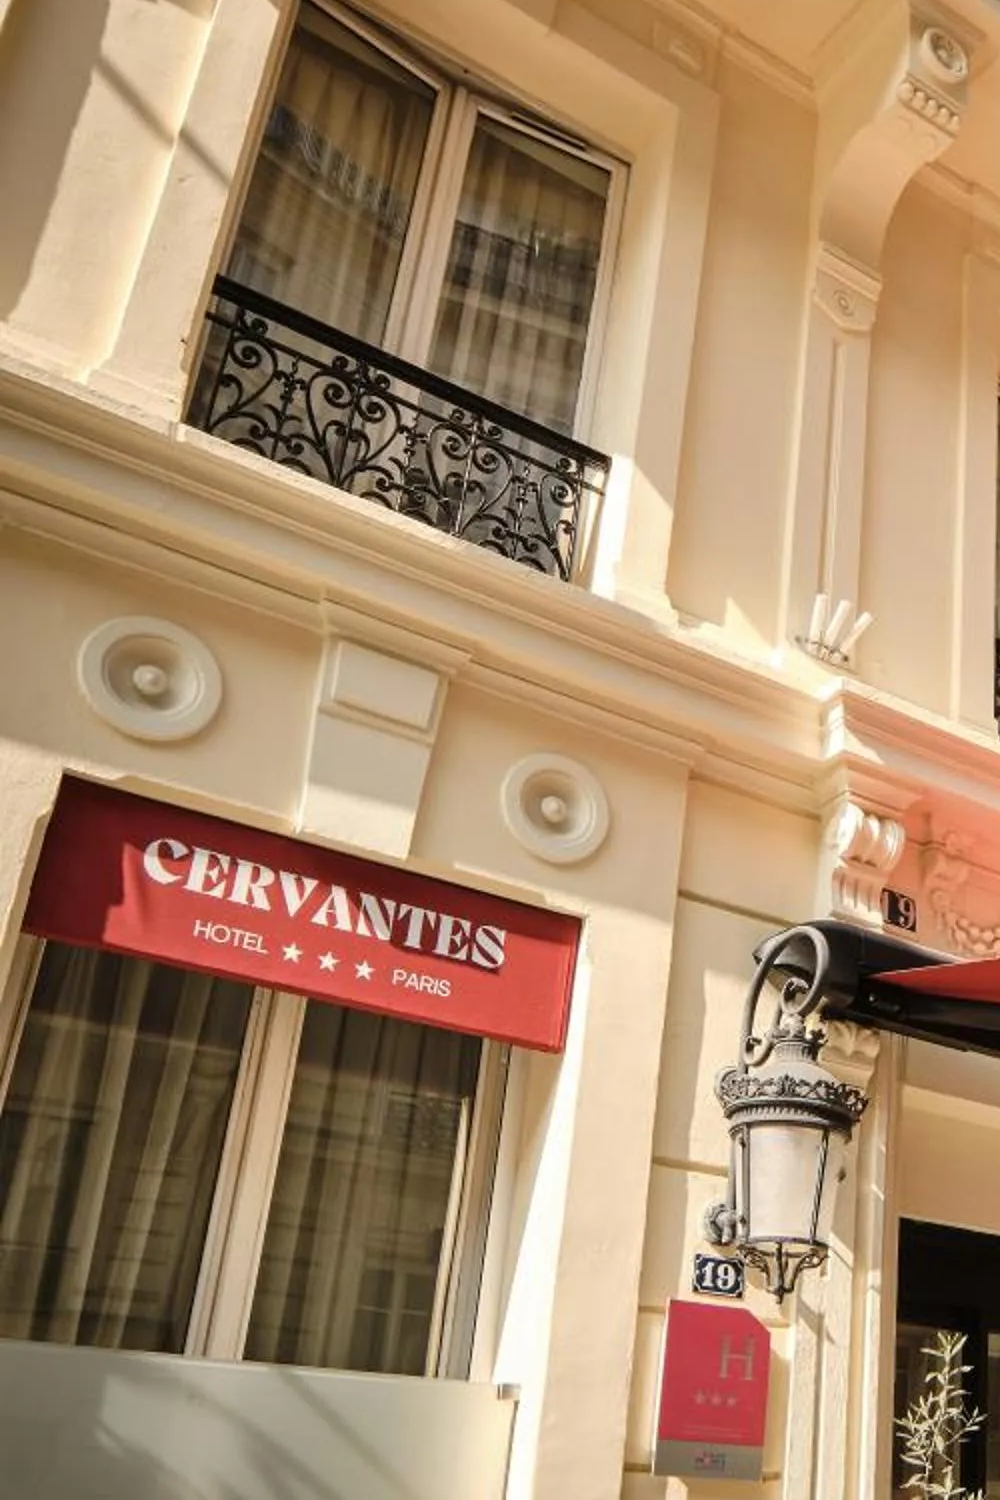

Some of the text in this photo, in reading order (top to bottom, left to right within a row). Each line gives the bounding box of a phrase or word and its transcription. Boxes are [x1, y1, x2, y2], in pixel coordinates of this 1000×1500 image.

[143, 837, 507, 970] CERVANTES
[883, 891, 916, 929] 19
[192, 918, 452, 998] HOTEL PARIS
[701, 1261, 736, 1290] 19
[719, 1335, 757, 1381] H
